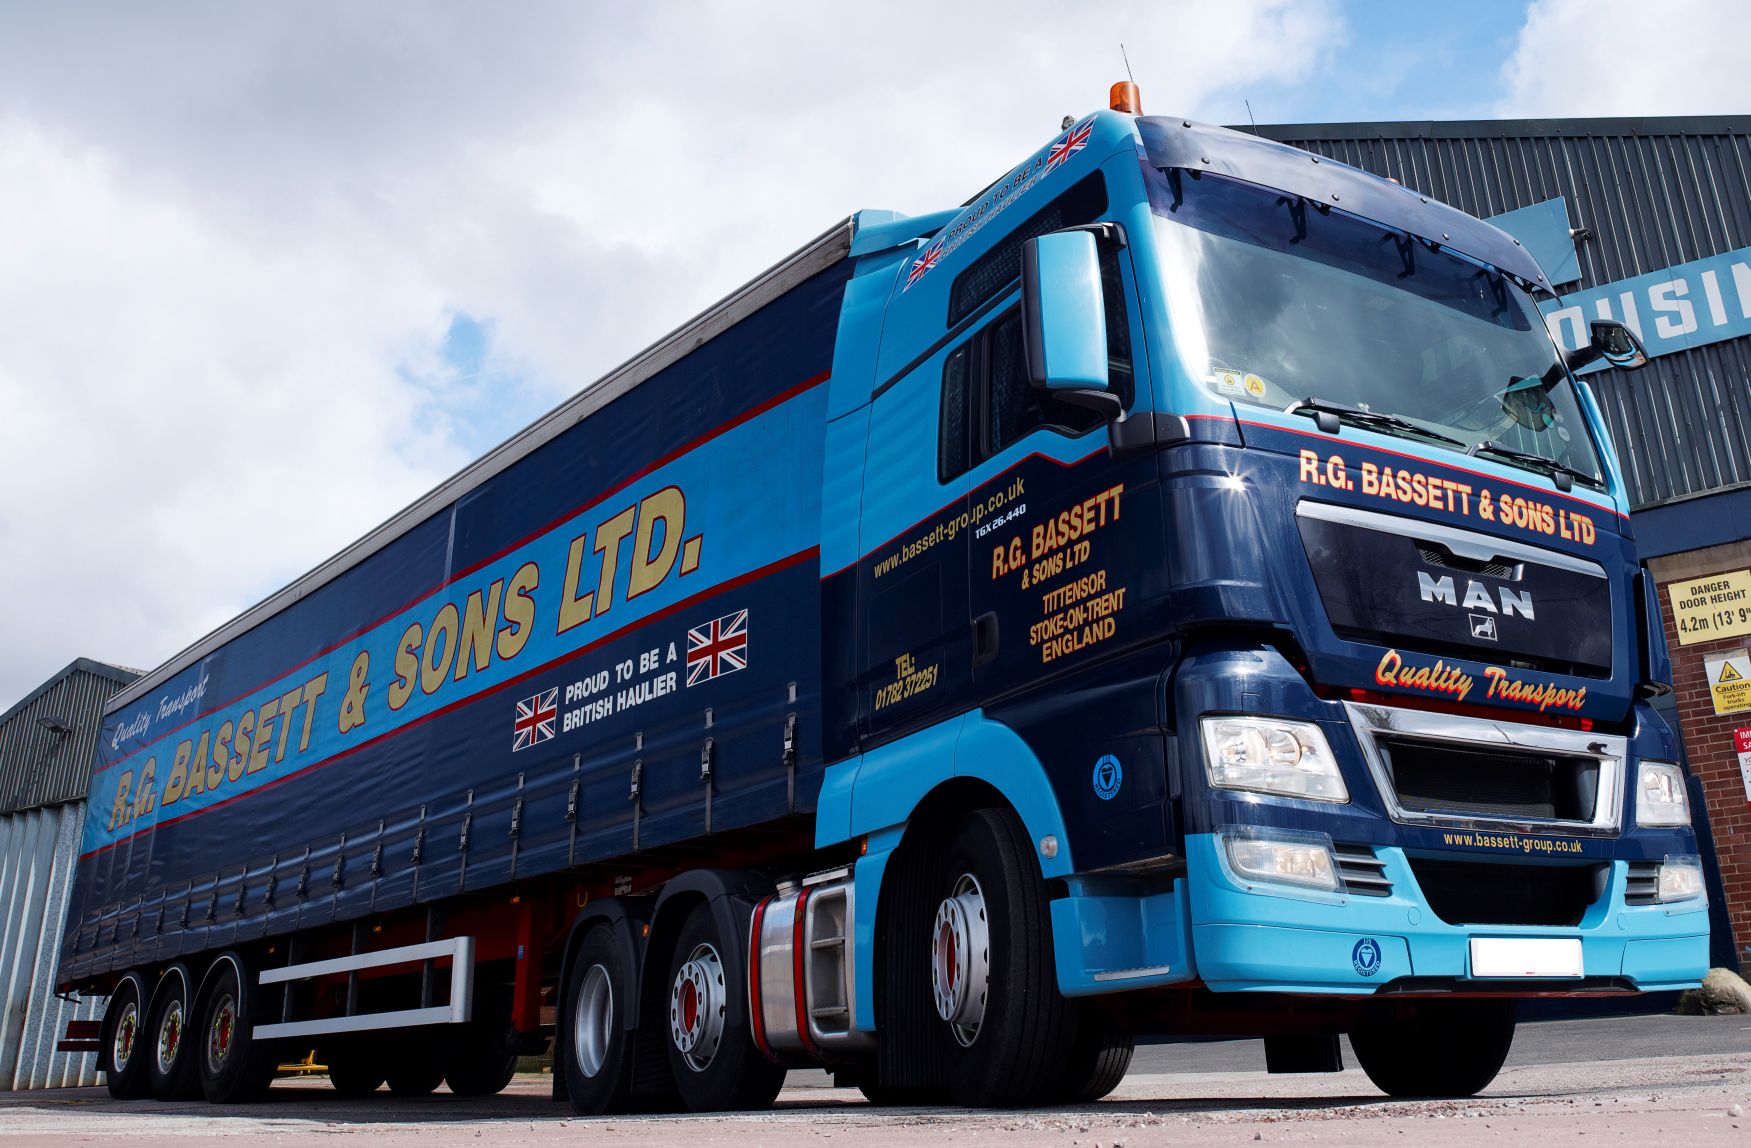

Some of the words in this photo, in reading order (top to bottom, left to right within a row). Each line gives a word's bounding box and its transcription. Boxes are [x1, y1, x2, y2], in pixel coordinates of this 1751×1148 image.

[947, 201, 989, 242] PROUD
[993, 184, 1009, 205] TO
[1012, 166, 1031, 190] BE
[1032, 156, 1042, 173] A
[1300, 448, 1353, 491] R.G.
[1361, 462, 1472, 516] BASSETT
[1479, 489, 1495, 520] &
[1500, 493, 1555, 536] SONS
[1559, 508, 1596, 545] LTD
[975, 523, 992, 540] TGX
[992, 503, 1027, 529] 26.440
[992, 536, 1026, 580] R.G.
[1031, 483, 1124, 560] BASSETT
[1021, 568, 1030, 590] &
[1032, 552, 1064, 585] SONS
[1065, 540, 1090, 569] LTD
[1690, 580, 1730, 596] DANGER
[1042, 569, 1106, 614] TITTENSOR
[1417, 570, 1536, 621] MAN
[1679, 597, 1707, 610] DOOR
[1710, 589, 1746, 604] HEIGHT
[1029, 588, 1126, 645] STOKE-ON-TRENT
[1042, 617, 1116, 663] ENGLAND
[1680, 616, 1709, 633] 4.2m
[1713, 610, 1735, 631] (13'
[107, 756, 157, 832] R.G.
[161, 672, 328, 806] BASSETT
[338, 650, 371, 734] &
[388, 561, 540, 711] SONS
[556, 484, 703, 635] LTD.
[565, 671, 609, 704] PROUD
[615, 659, 633, 681] TO
[639, 651, 660, 676] BE
[665, 641, 678, 663] A
[895, 653, 915, 680] TEL:
[1375, 649, 1473, 701] Quality
[1483, 666, 1586, 711] Transport
[111, 713, 151, 750] Quality
[156, 673, 210, 722] Transport
[562, 700, 614, 732] BRITISH
[616, 672, 677, 712] HAULIER
[875, 675, 902, 711] 01782
[904, 664, 938, 698] 372251
[1715, 683, 1751, 693] Caution
[1723, 692, 1746, 700] Fork-lift
[1444, 833, 1583, 853] www.bassett-group.co.uk
